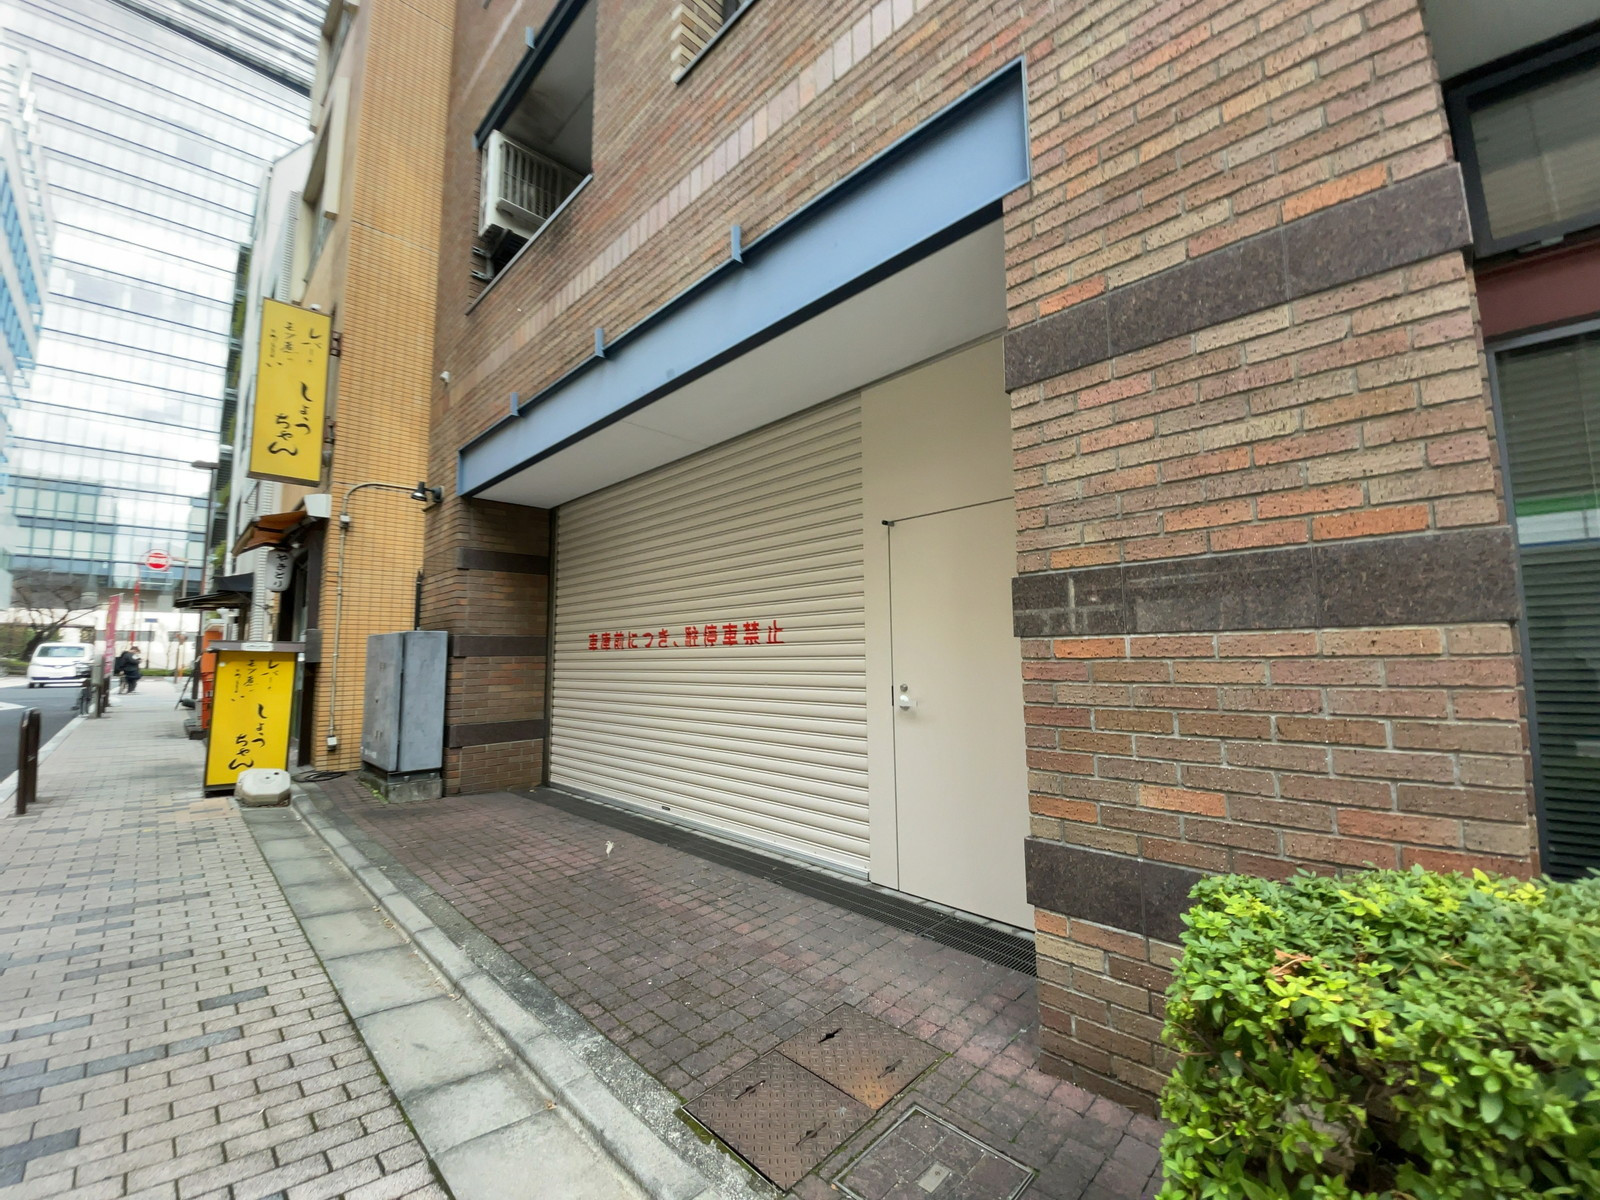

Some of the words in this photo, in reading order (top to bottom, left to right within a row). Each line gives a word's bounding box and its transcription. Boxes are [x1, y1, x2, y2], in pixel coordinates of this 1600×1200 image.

[267, 412, 298, 457] ちゃん
[273, 553, 289, 588] やきとり
[588, 619, 785, 651] 車庫前につき、駐停車禁止
[251, 703, 267, 748] しょう
[228, 733, 254, 770] ちゃん
